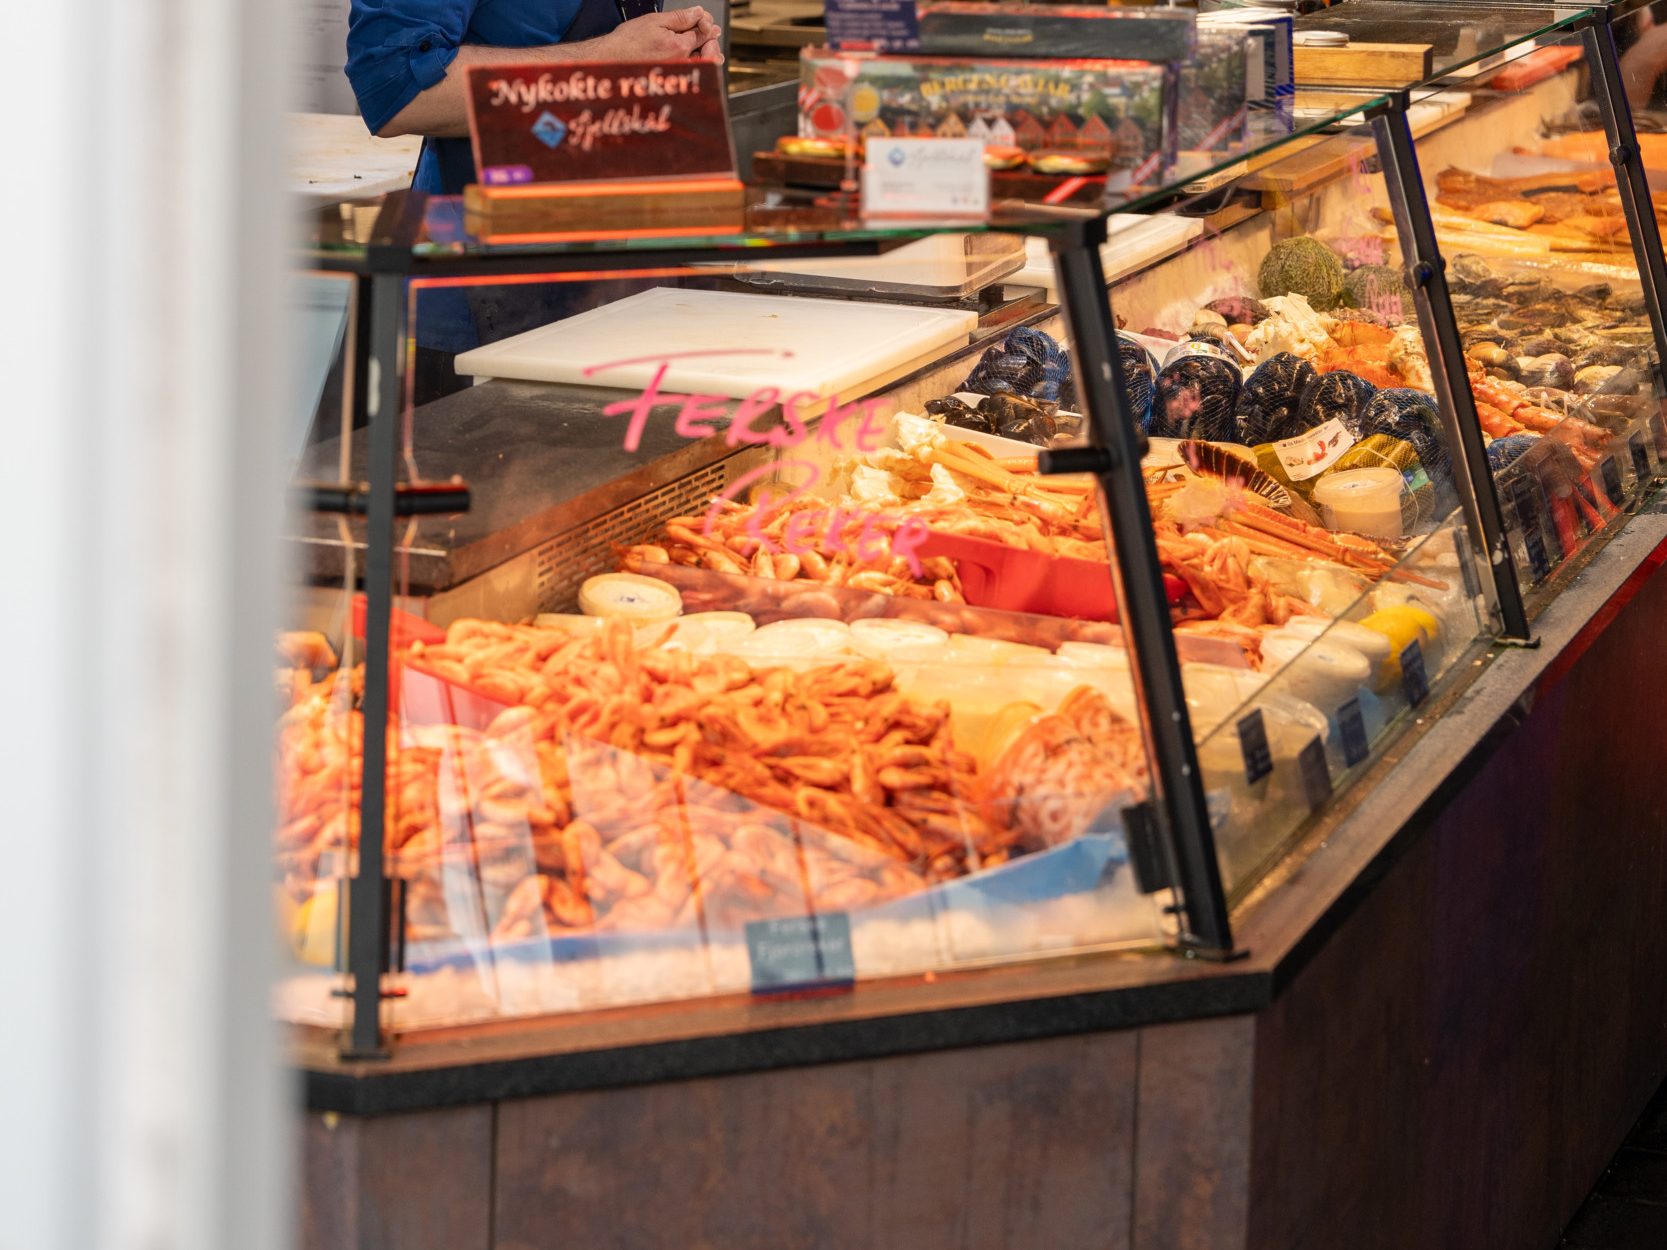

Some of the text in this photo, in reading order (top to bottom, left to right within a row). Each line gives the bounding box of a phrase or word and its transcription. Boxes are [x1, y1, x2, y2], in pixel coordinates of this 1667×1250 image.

[488, 67, 701, 113] Nykokte reker!
[583, 349, 893, 452] FERSKE
